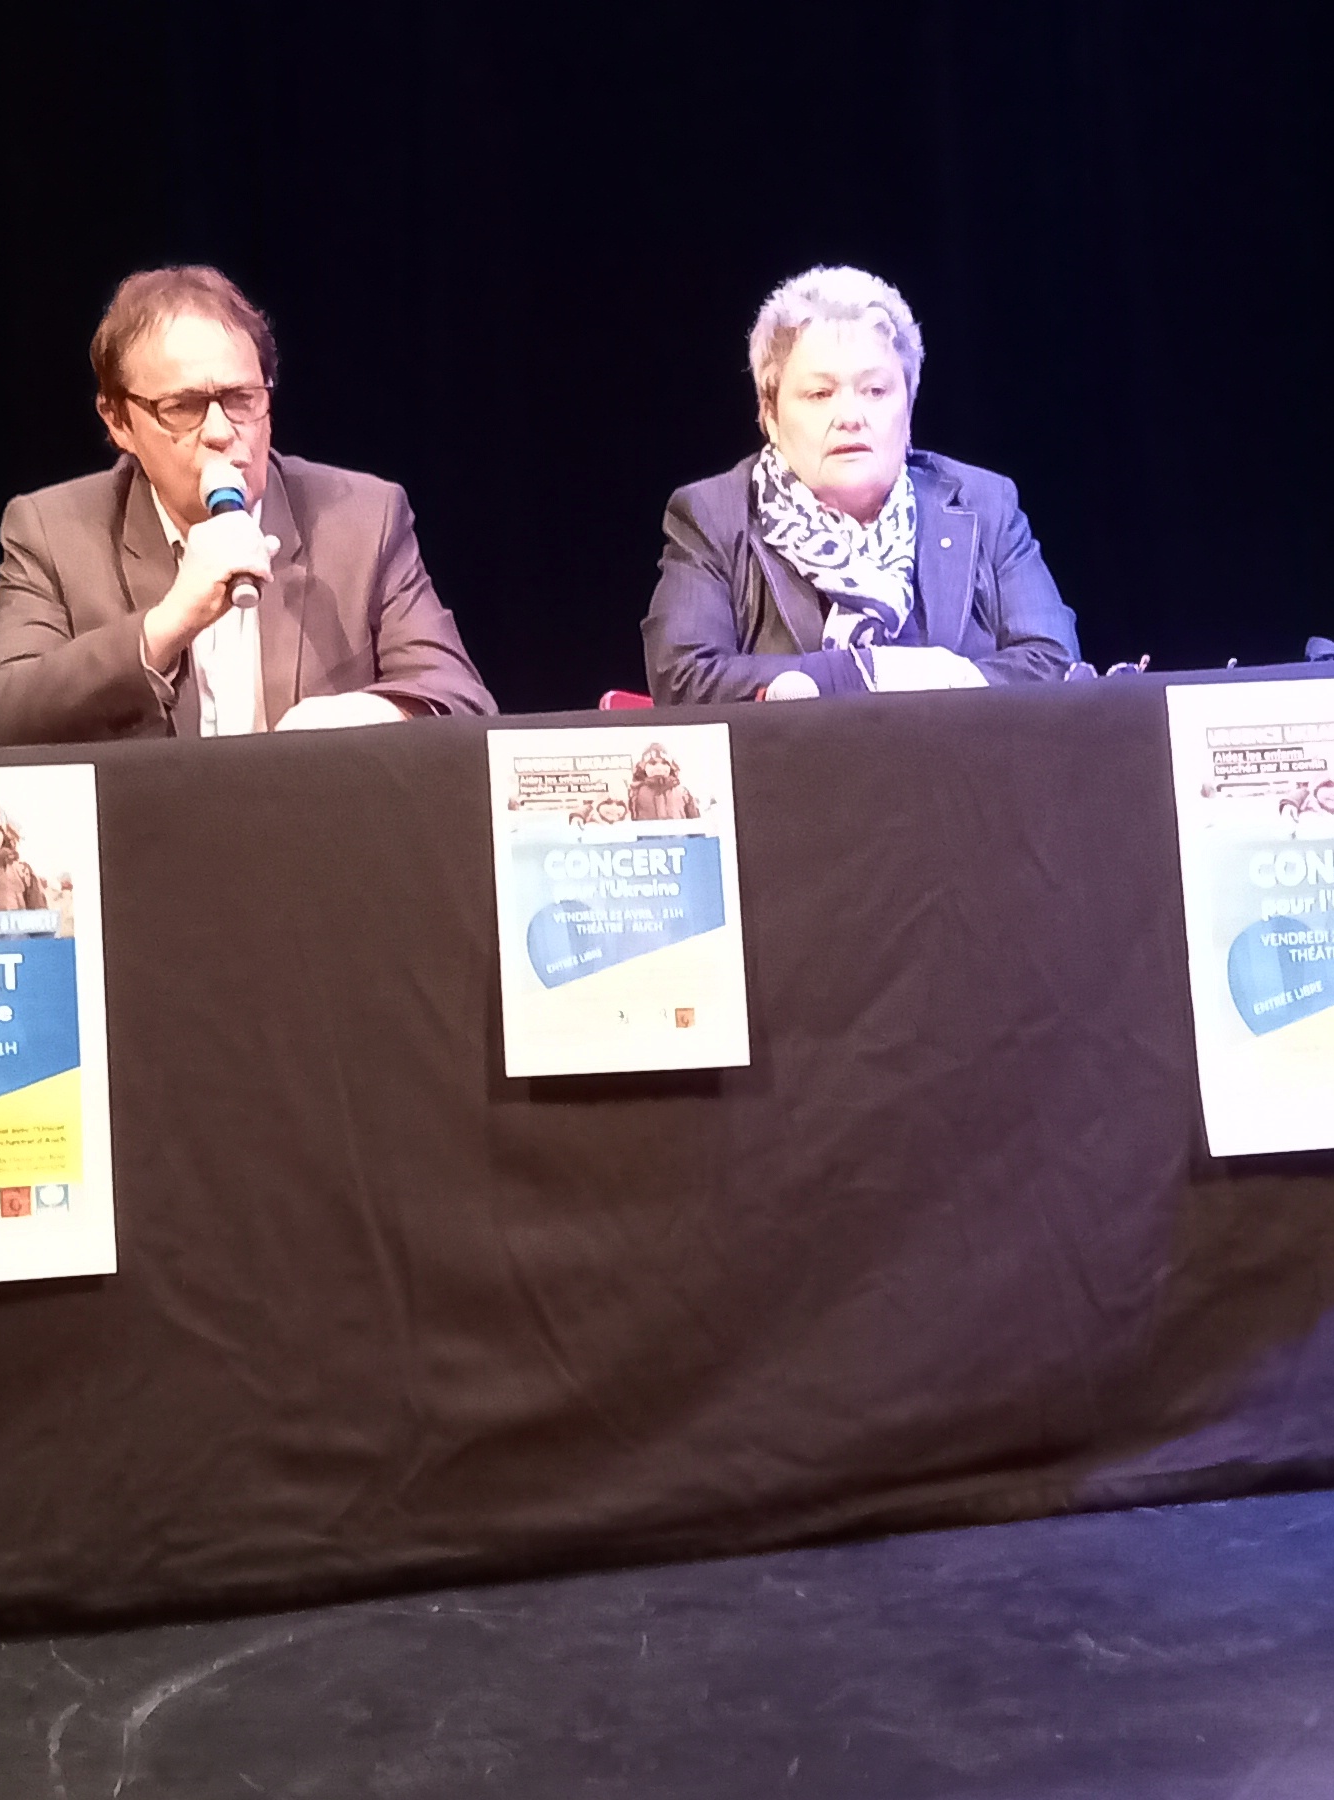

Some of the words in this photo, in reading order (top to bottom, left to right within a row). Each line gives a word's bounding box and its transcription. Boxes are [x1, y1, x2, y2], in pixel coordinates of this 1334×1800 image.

[544, 847, 685, 879] CONCERT
[599, 879, 680, 898] l'Ukraine
[1261, 896, 1315, 922] pour
[1260, 929, 1328, 947] VENDREDI
